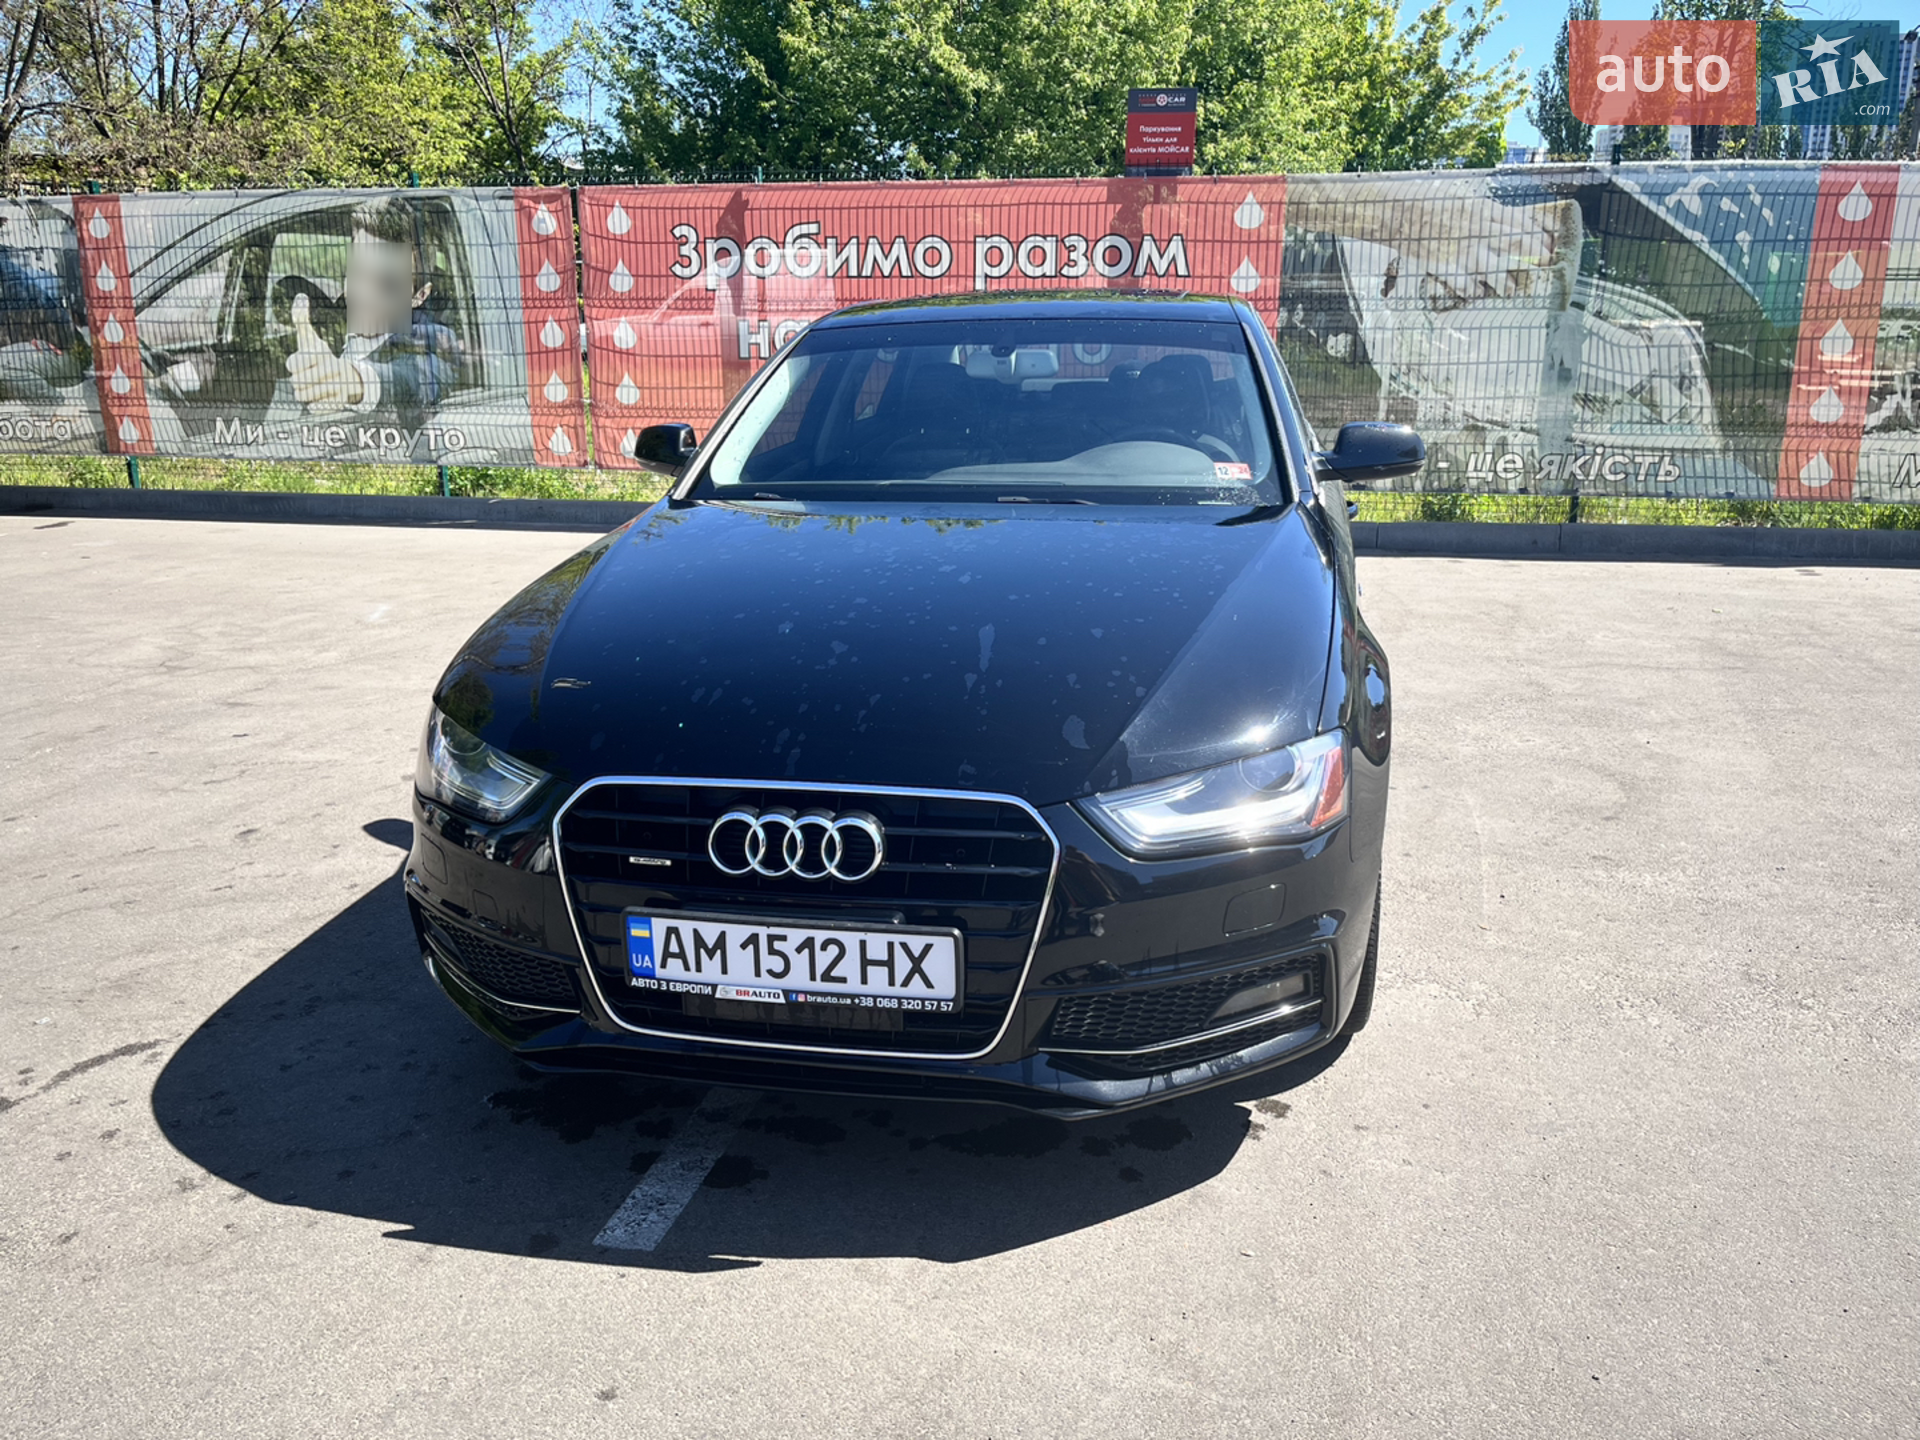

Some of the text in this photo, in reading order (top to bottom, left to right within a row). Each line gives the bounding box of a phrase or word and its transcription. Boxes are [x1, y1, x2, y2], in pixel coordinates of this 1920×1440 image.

[1139, 125, 1182, 133] Паркування
[669, 221, 1191, 291] Зробимо разом
[214, 416, 265, 445] Ми
[301, 424, 347, 451] це
[358, 425, 467, 457] круто
[1218, 466, 1229, 475] 12
[1465, 450, 1524, 483] це
[1535, 444, 1680, 482] якість
[632, 953, 653, 968] UA
[659, 926, 935, 989] AM 1512 HX
[631, 977, 658, 989] АВТО
[670, 982, 712, 995] ЄВРОПИ
[735, 989, 781, 999] BRAUTO
[807, 994, 954, 1011] brauto.ua +38 068 320 57 57
